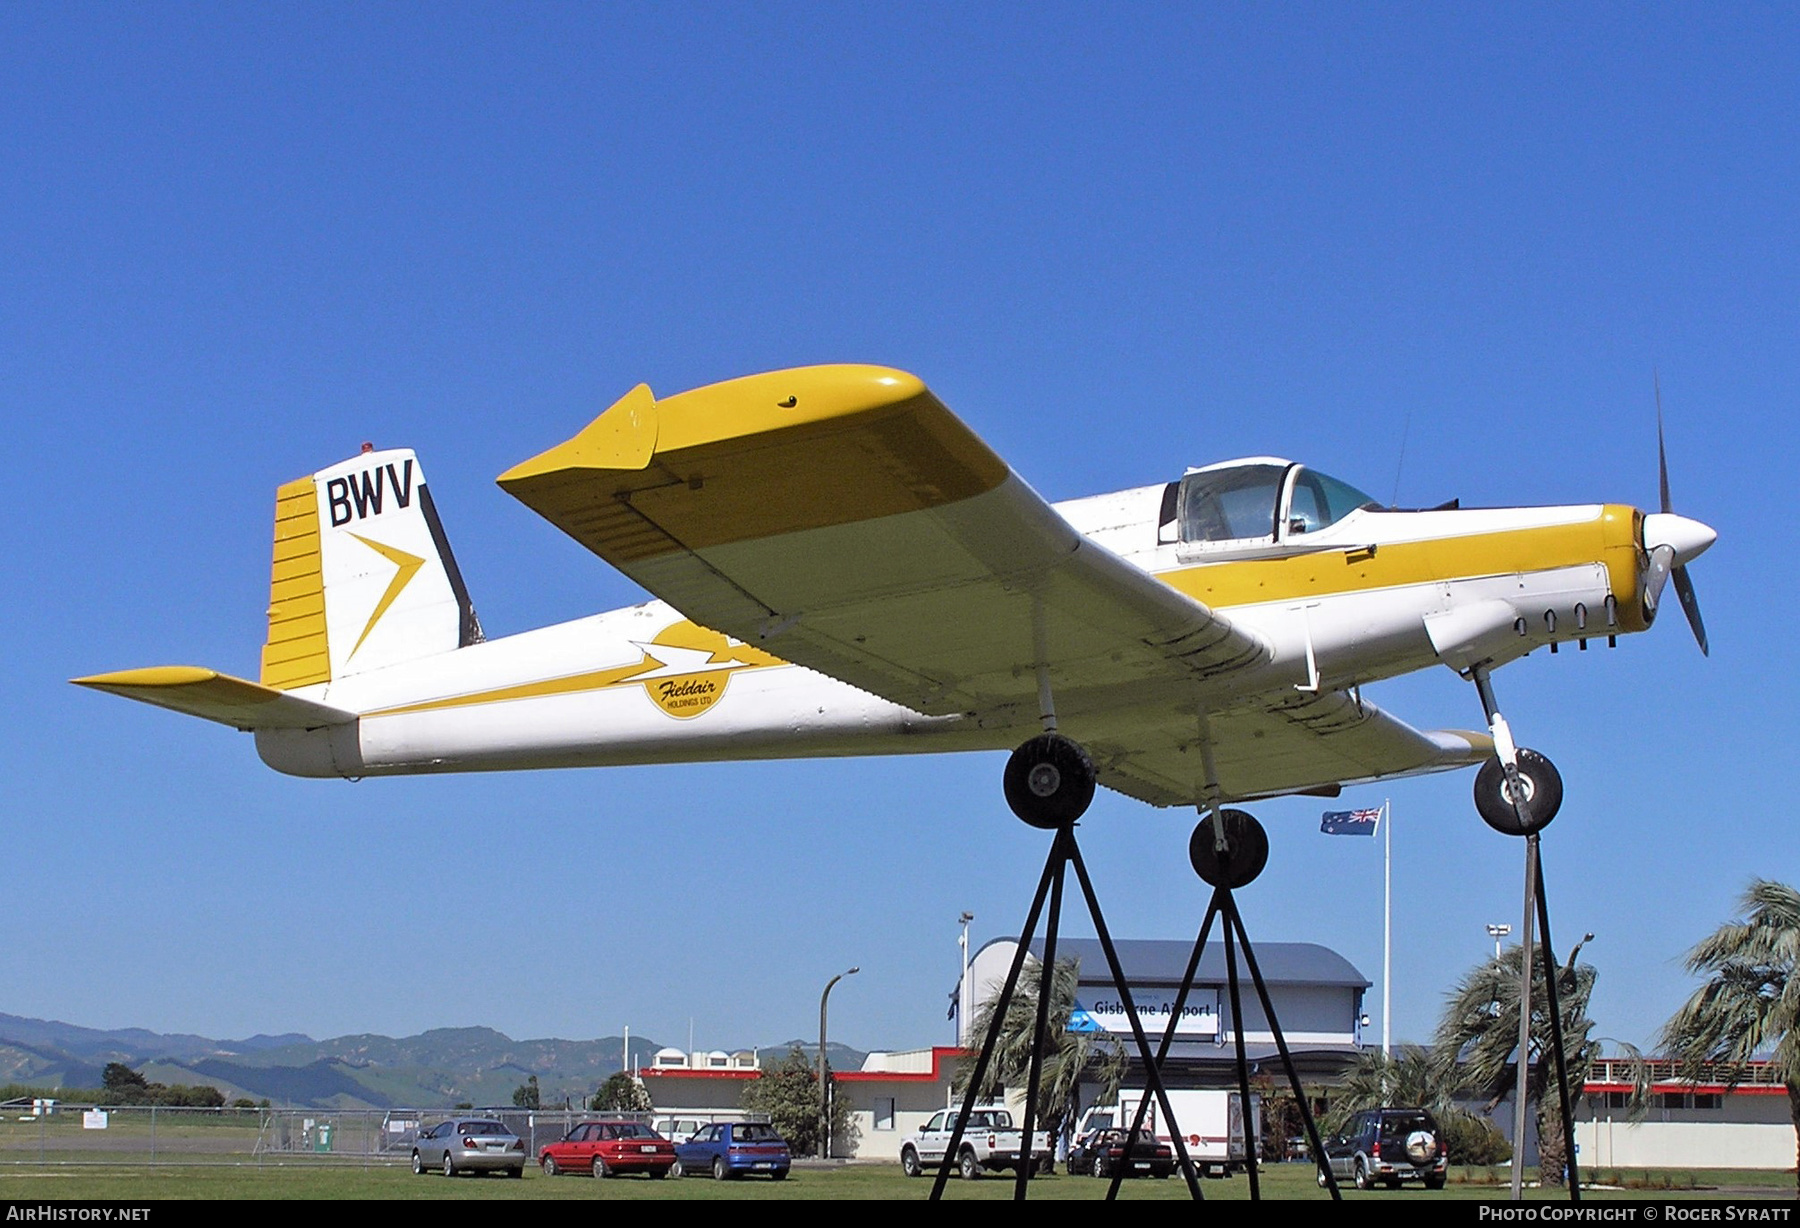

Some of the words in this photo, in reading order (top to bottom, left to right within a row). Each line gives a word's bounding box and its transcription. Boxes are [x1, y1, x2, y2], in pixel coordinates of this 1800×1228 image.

[327, 460, 413, 527] BWV
[659, 680, 715, 702] Fieldair
[667, 698, 698, 708] HOLDINGS
[700, 696, 712, 704] LTD
[1095, 1001, 1155, 1015] Gisbne
[1161, 1003, 1210, 1019] Aiport
